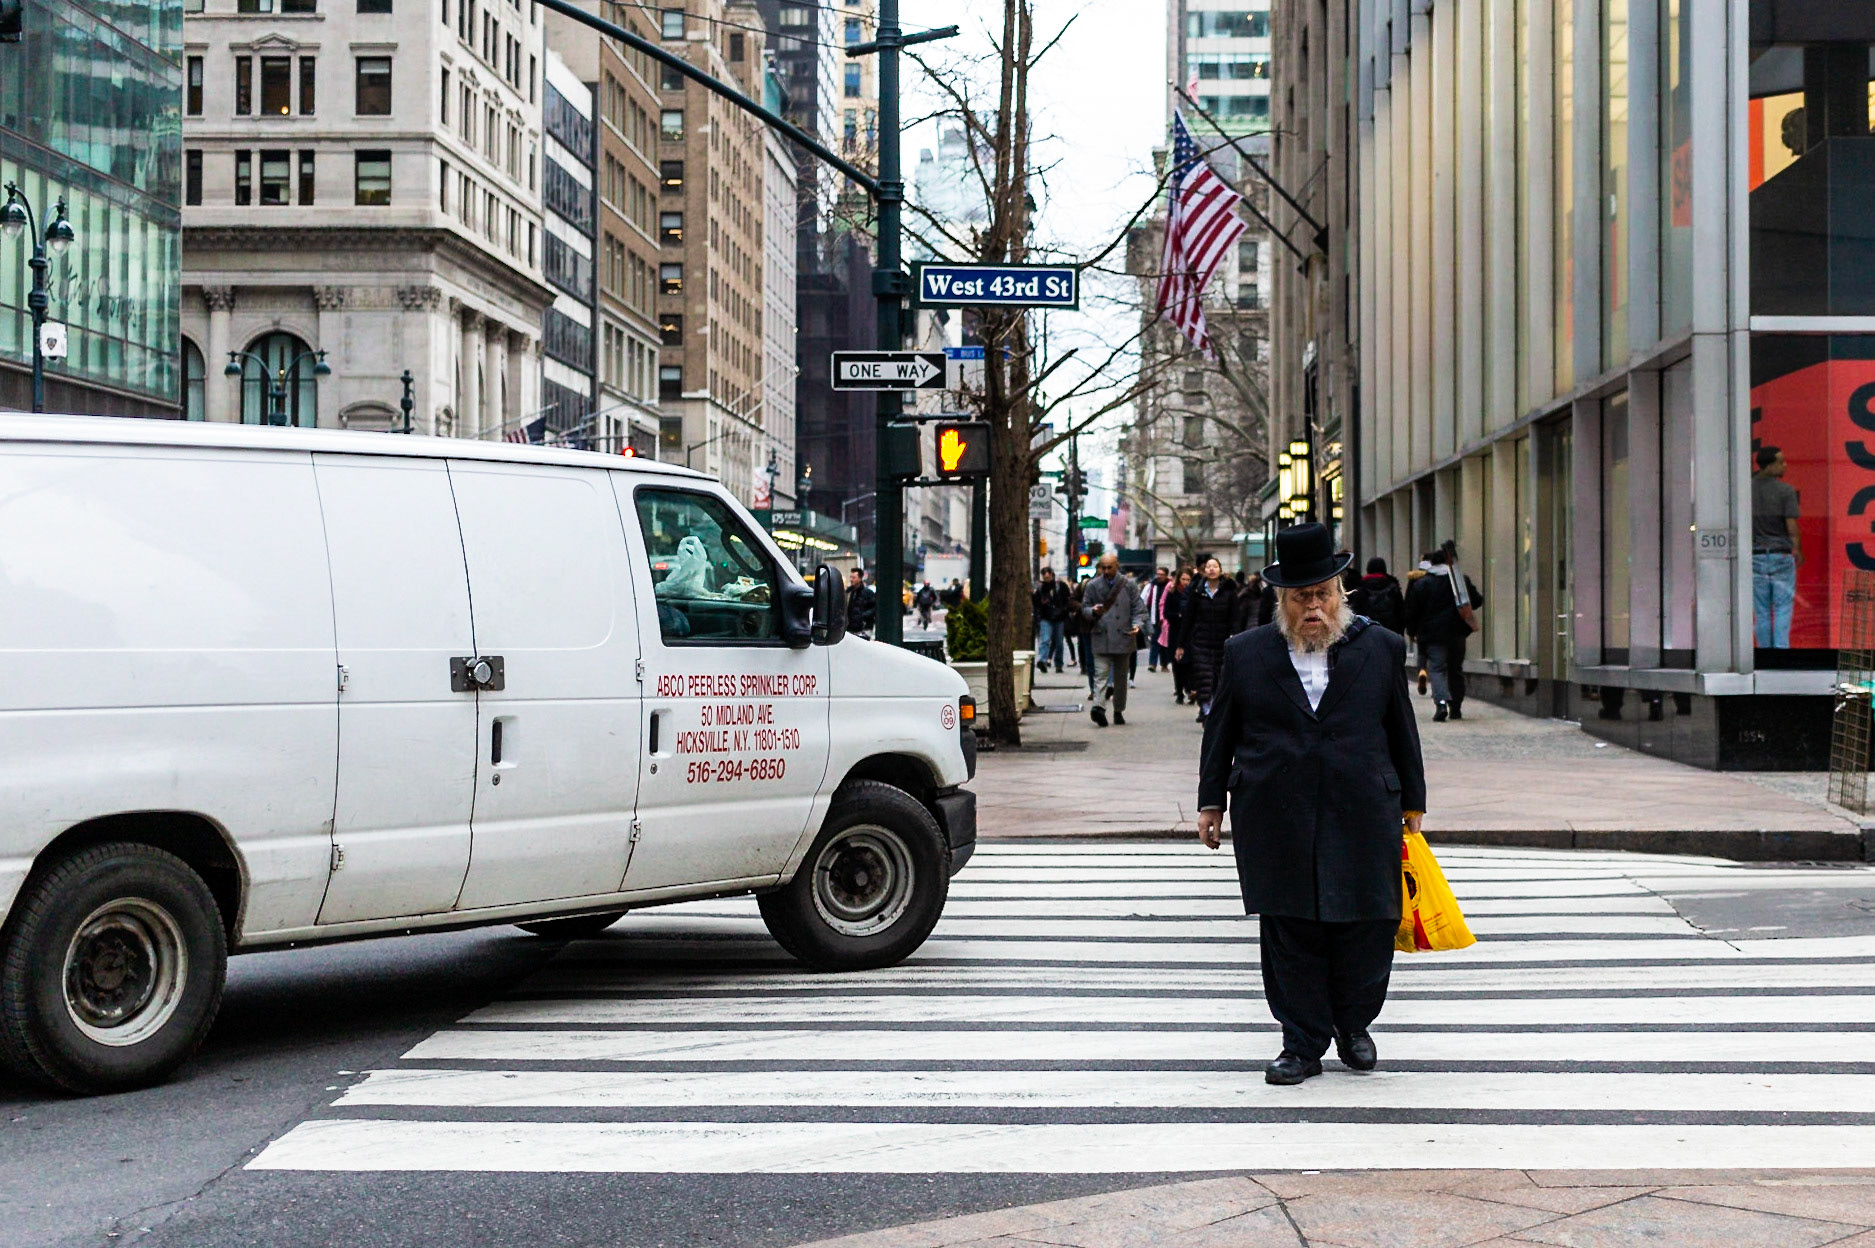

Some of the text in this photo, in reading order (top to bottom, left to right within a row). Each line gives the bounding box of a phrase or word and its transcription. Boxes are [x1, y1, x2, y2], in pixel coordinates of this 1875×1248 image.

[926, 274, 1069, 298] West 43rd St
[849, 364, 930, 378] ONE WAY
[1701, 534, 1726, 548] 510
[656, 674, 819, 697] ABCO PEERLESS SPRINKLER CORP.
[701, 704, 775, 726] 50 MIDLAND AVE.
[676, 728, 800, 755] HICKSVILLE, N.Y. 11801-1510
[686, 758, 786, 784] 516-294-6850
